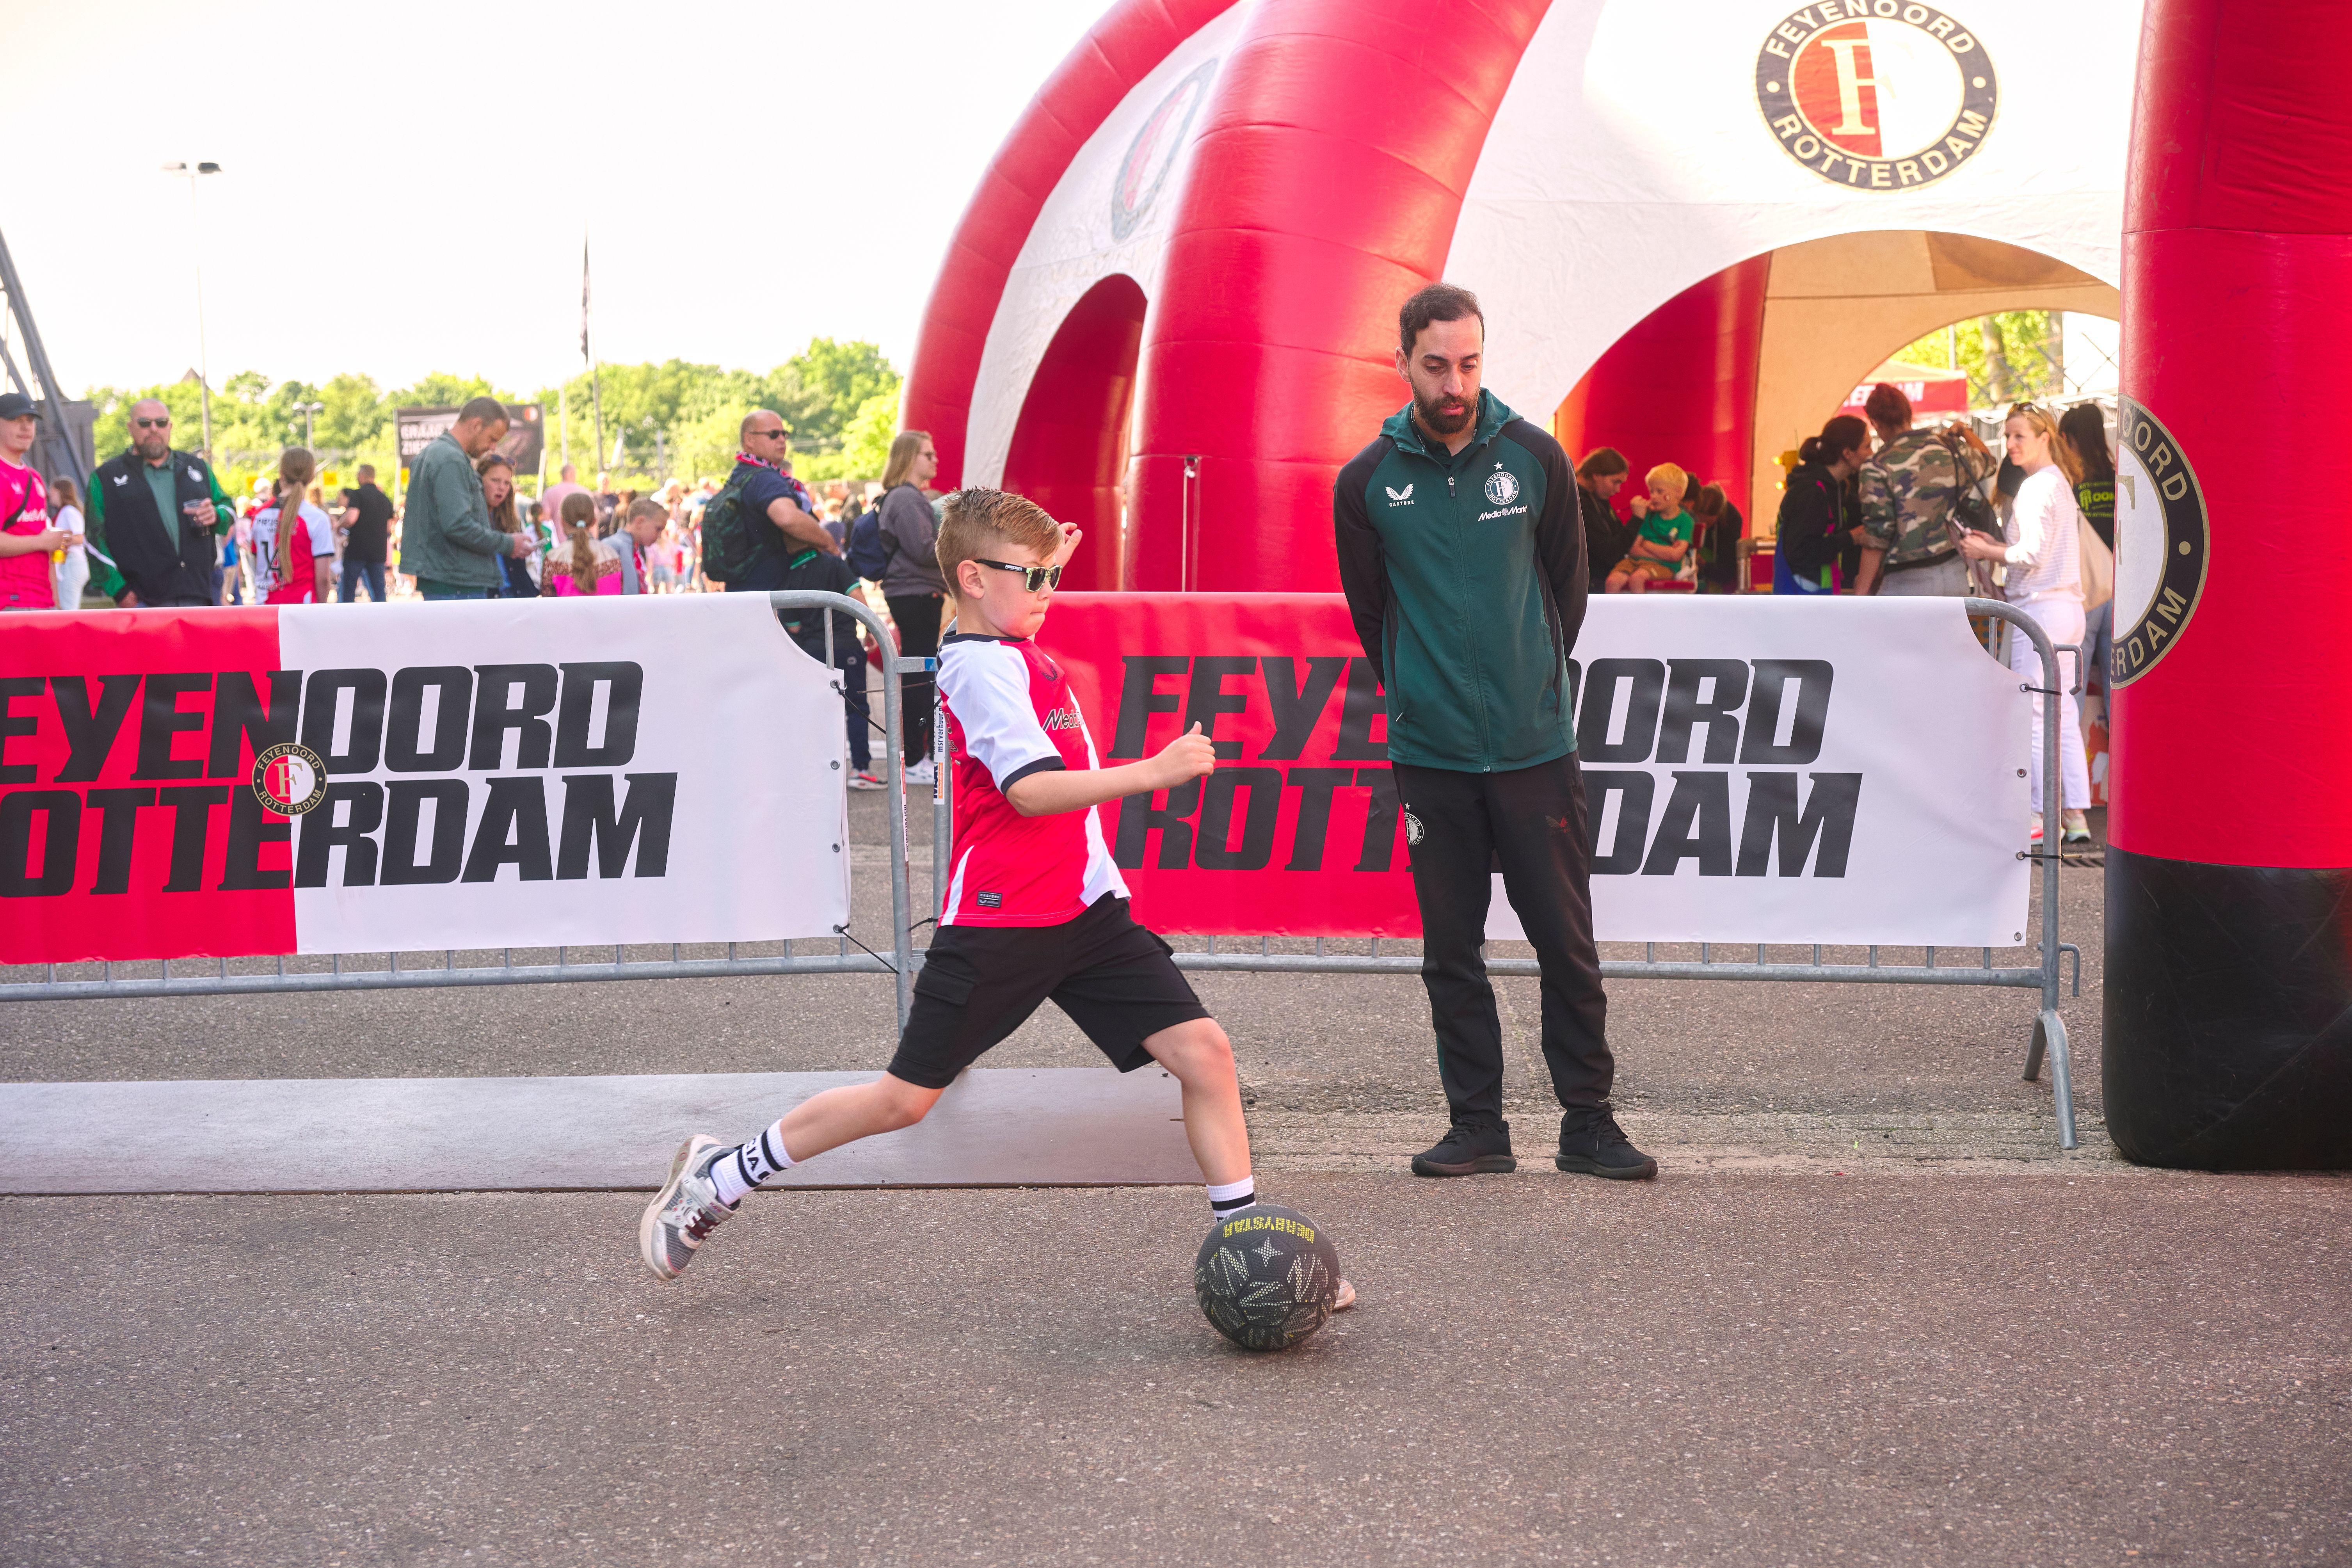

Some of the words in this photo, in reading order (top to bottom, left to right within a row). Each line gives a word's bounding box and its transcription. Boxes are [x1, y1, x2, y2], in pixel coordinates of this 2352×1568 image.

[1765, 0, 1975, 59] FEYENOORD
[1773, 109, 1988, 187] ROTTERDAM
[1486, 473, 1515, 486] FEYENOORD
[1489, 490, 1517, 503] ROTTERDAM
[258, 746, 320, 770] FEYENOORD
[274, 763, 303, 797] F
[259, 789, 322, 814] ROTTERDAM
[1223, 1216, 1314, 1244] DERBYSTAR
